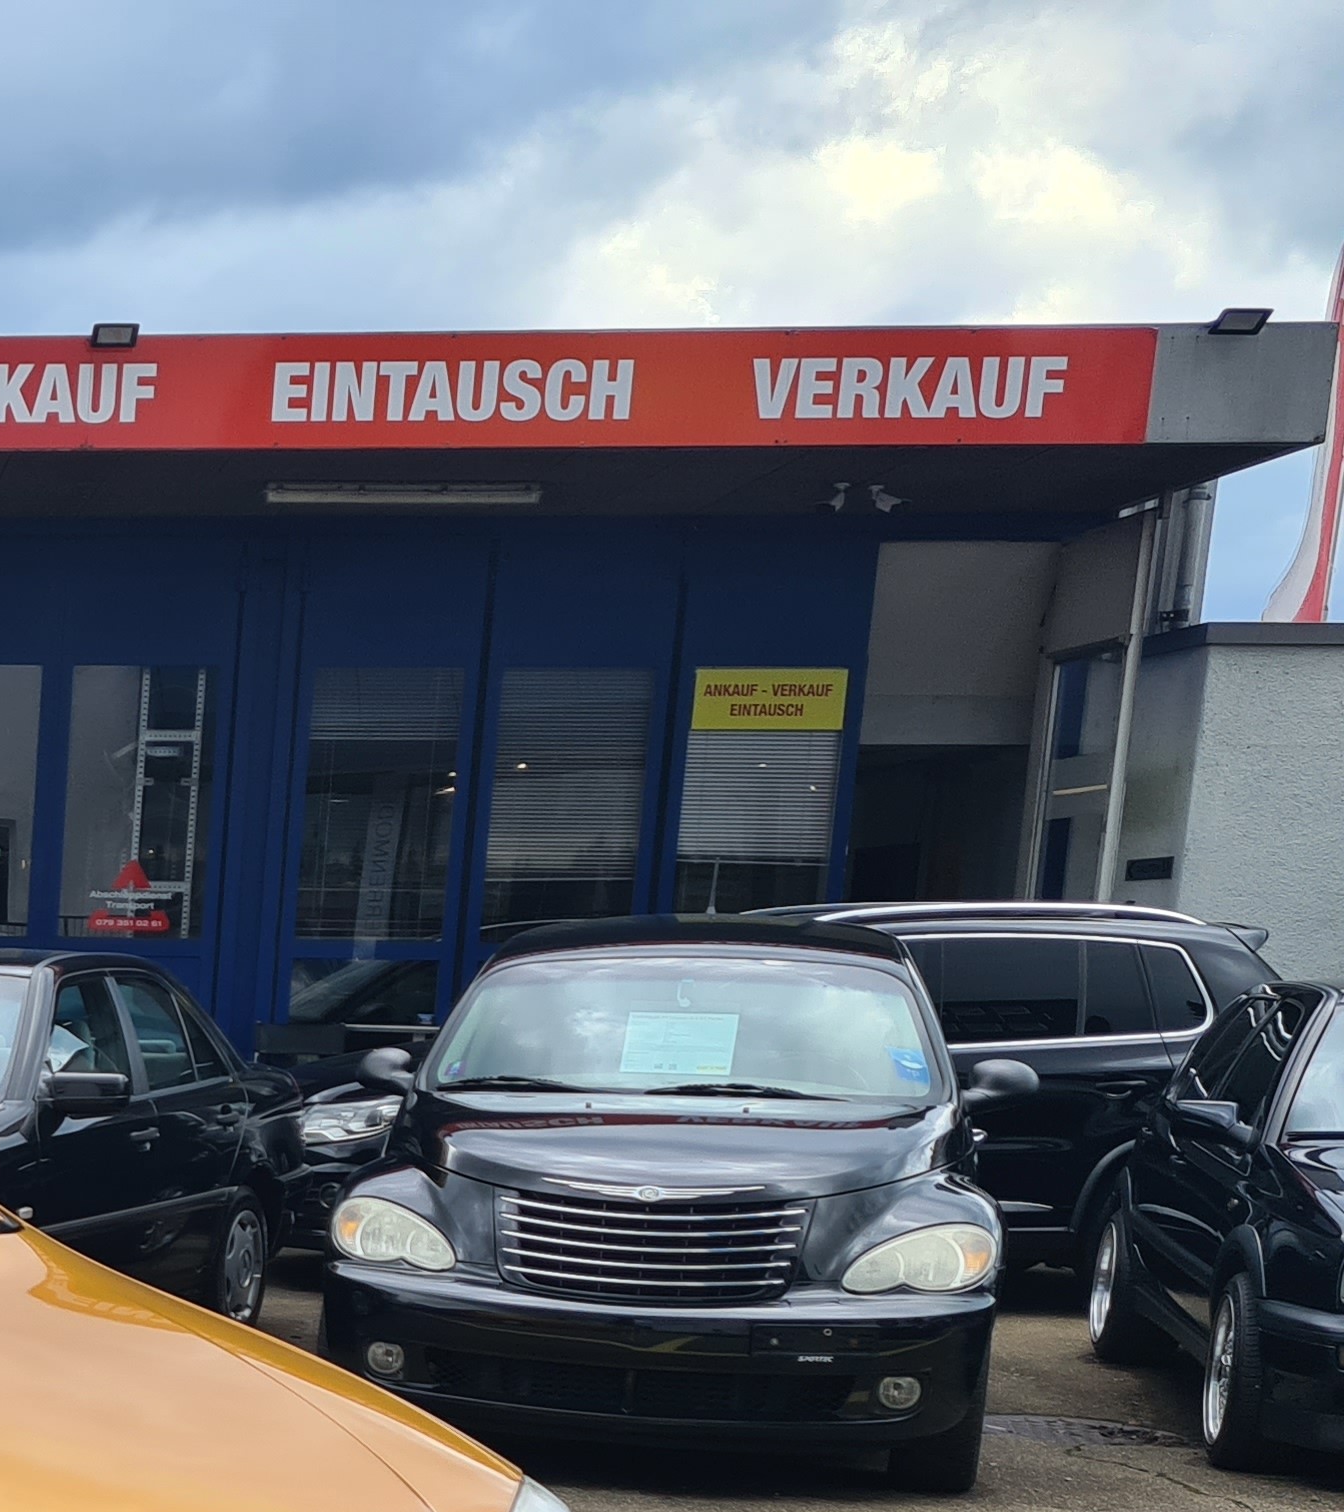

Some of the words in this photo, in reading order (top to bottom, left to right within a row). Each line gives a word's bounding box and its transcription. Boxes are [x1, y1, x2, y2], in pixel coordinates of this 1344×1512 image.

[270, 358, 635, 423] EINTAUSCH
[753, 355, 1069, 420] VERKAUF
[703, 683, 759, 697] ANKAUF
[771, 683, 834, 698] VERKAUF
[729, 703, 804, 717] EINTAUSCH
[105, 900, 155, 911] Transport
[95, 918, 114, 926] 079
[135, 919, 150, 927] 02
